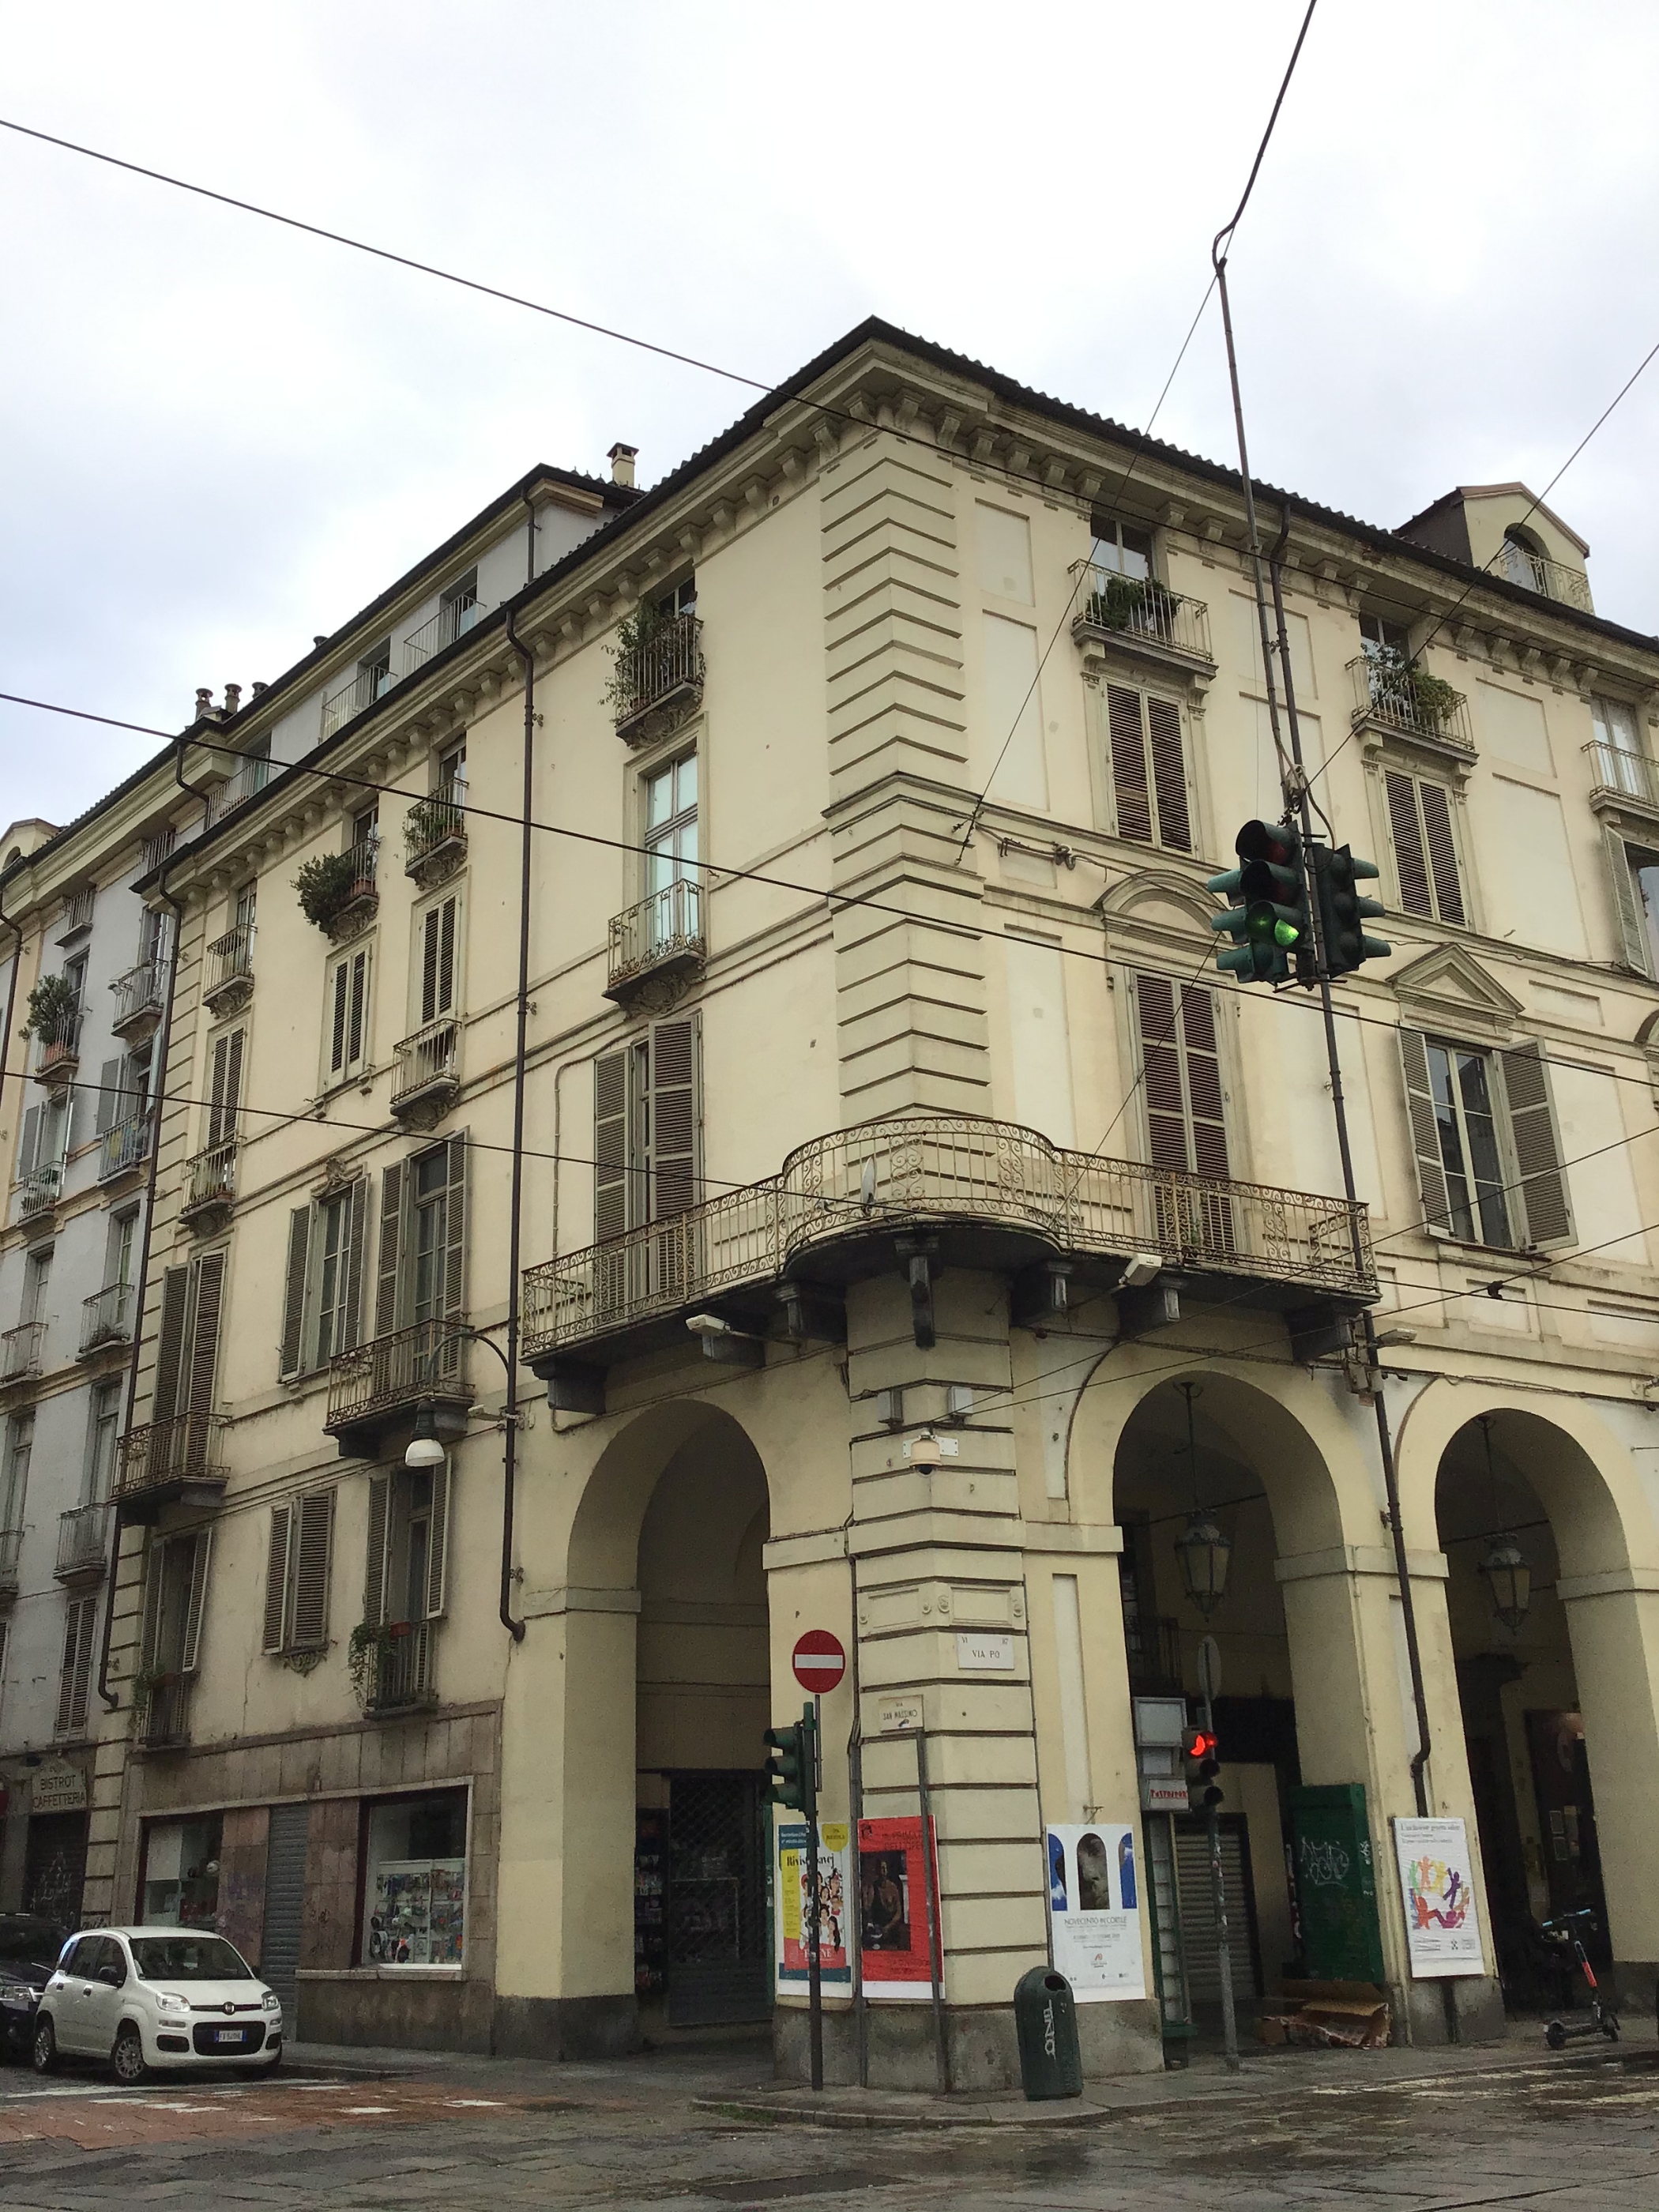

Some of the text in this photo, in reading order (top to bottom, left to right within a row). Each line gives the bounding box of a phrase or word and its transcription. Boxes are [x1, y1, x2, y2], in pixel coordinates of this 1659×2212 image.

[972, 1650, 1000, 1658] VIA PO
[883, 1709, 918, 1721] SAN MASSIMO
[40, 1774, 77, 1790] BISTROT
[32, 1791, 85, 1808] CAFFETTERIA
